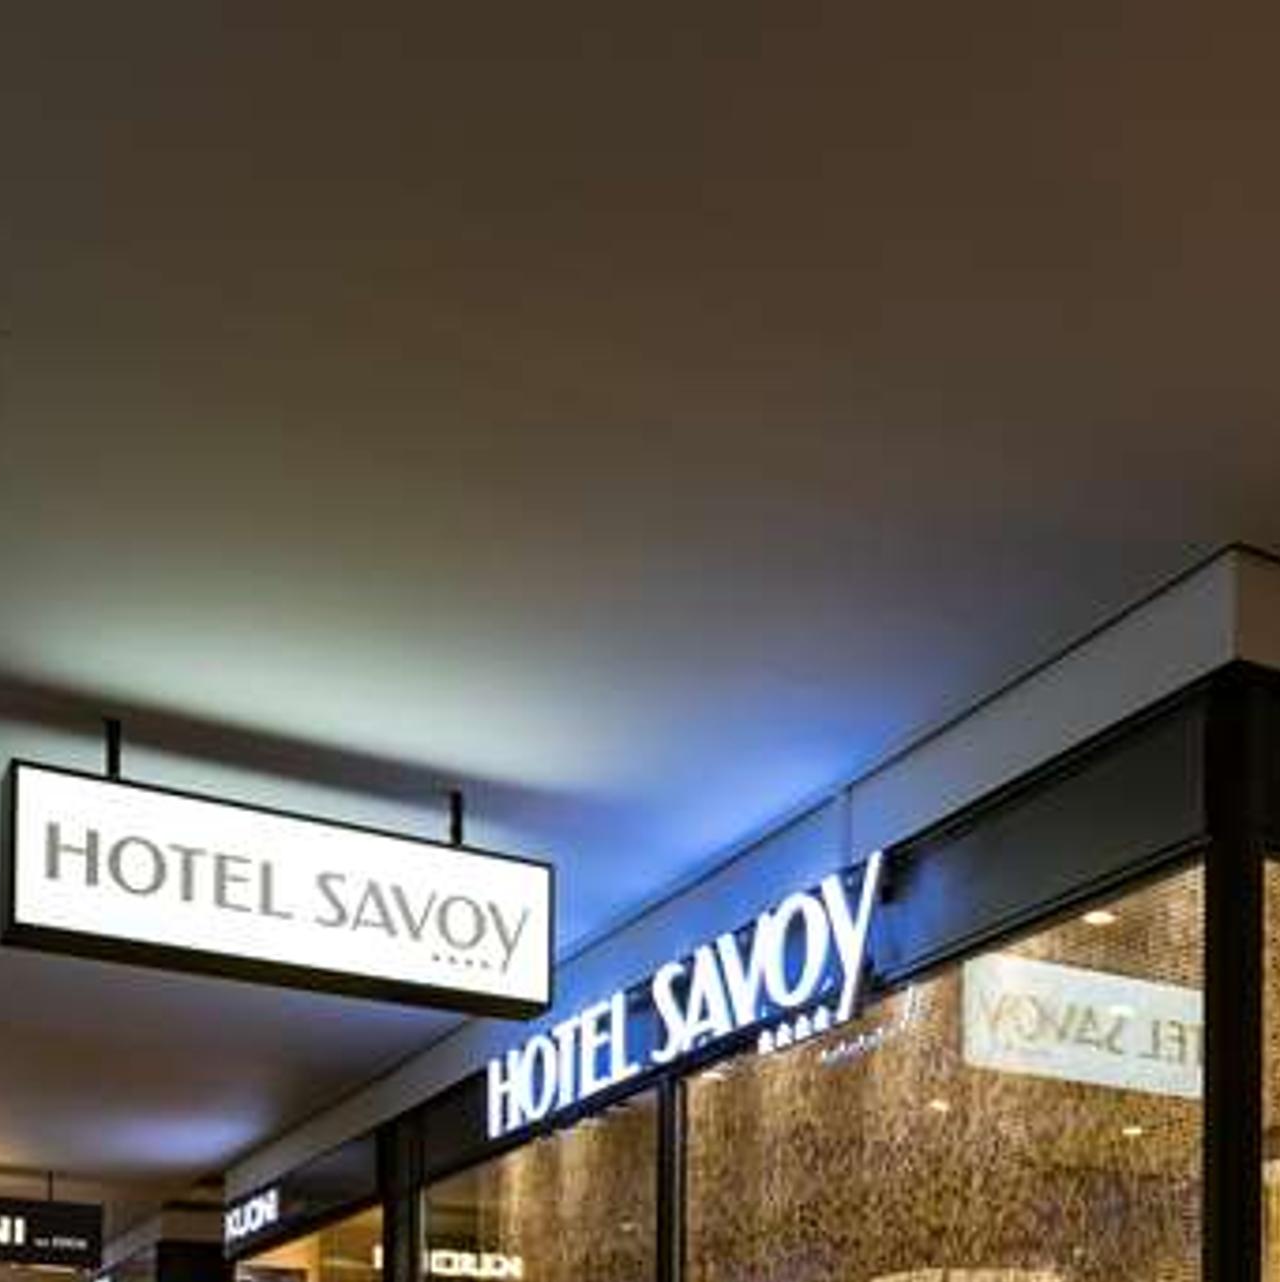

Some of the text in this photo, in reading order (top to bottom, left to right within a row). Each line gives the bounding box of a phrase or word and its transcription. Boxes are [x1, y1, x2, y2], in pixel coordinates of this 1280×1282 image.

[45, 821, 531, 973] HOTEL SAVOY
[487, 850, 884, 1140] HOTEL SAVOY
